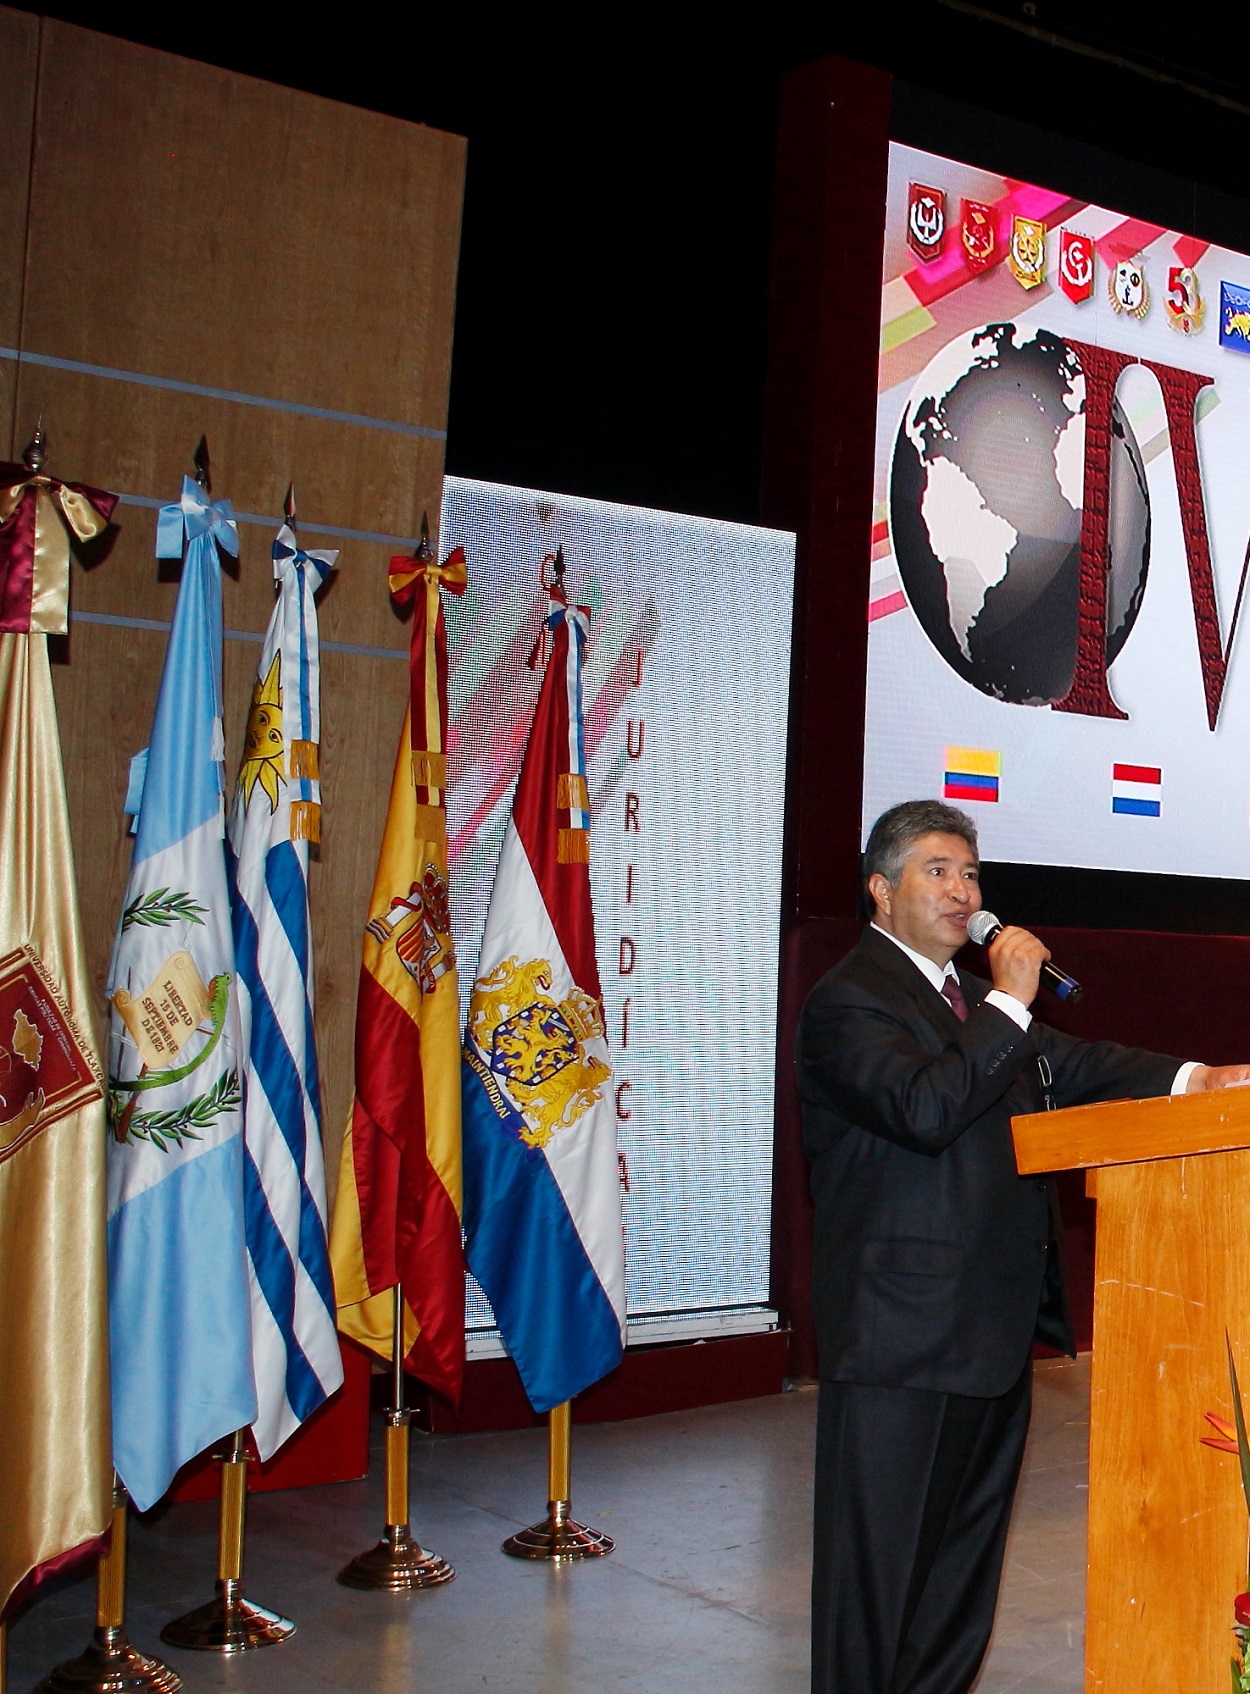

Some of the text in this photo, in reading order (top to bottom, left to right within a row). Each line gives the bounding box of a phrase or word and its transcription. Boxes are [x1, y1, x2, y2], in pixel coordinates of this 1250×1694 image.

[24, 943, 59, 994] UNIVERSIDAD
[78, 1039, 90, 1053] DE
[160, 999, 179, 1027] 15 DE
[163, 980, 193, 1026] LIBERTAD
[141, 997, 179, 1055] SEPTIEMBRE
[141, 1018, 165, 1053] DE 1821
